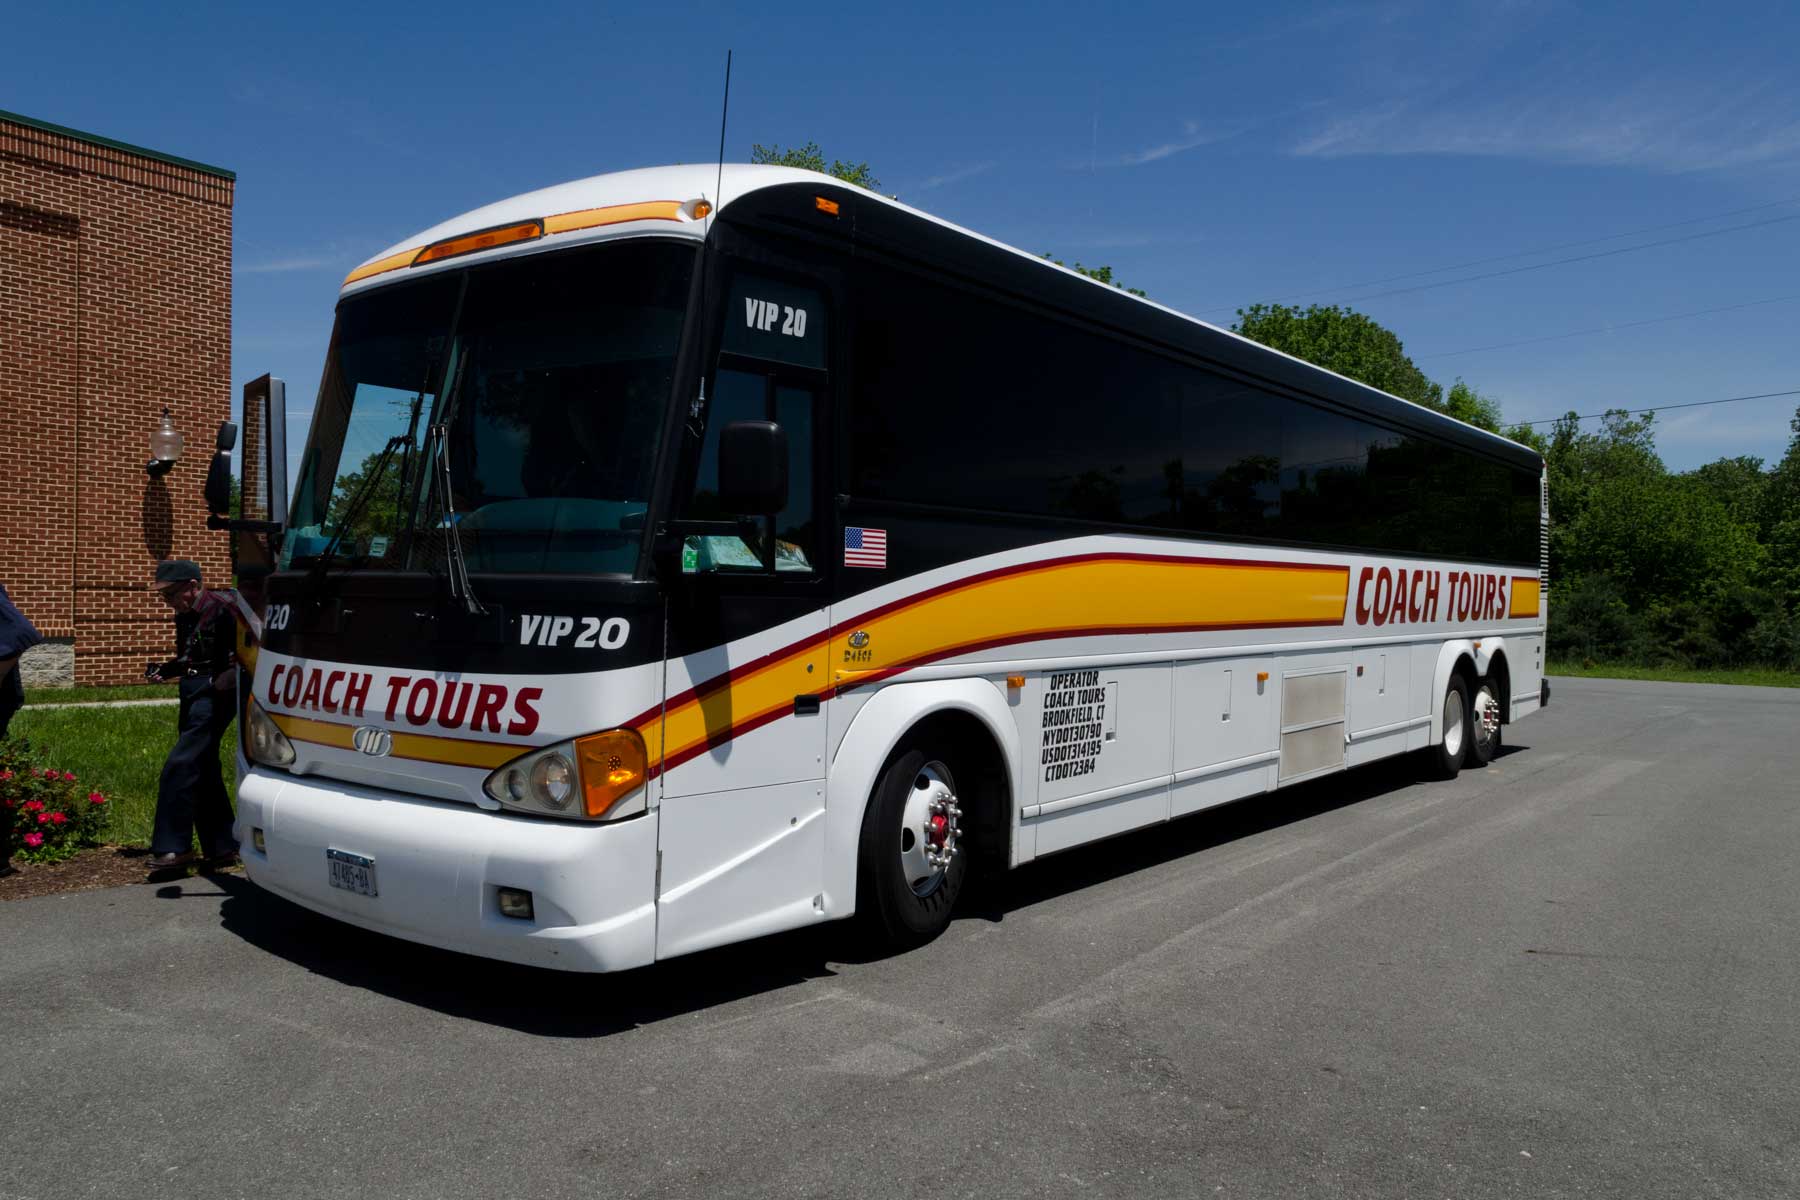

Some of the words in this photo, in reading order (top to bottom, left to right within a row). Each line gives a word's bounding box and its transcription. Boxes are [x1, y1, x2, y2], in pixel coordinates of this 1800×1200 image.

[745, 297, 779, 332] VIP
[781, 305, 807, 339] 20
[1355, 566, 1441, 627] COACH
[1446, 570, 1507, 623] TOURS
[520, 614, 574, 647] VIP
[574, 616, 631, 650] 20
[1050, 671, 1099, 690] OPERATOR
[267, 664, 373, 718] COACH
[384, 675, 544, 736] TOURS
[1043, 690, 1075, 709] COACH
[1077, 687, 1106, 705] TOURS
[1042, 706, 1094, 728] BROOKFIELD,
[1096, 704, 1106, 721] CT
[1042, 722, 1102, 747] NYDOT30790
[1041, 739, 1102, 765] USDOT314195
[1044, 758, 1096, 782] CTDOT2384
